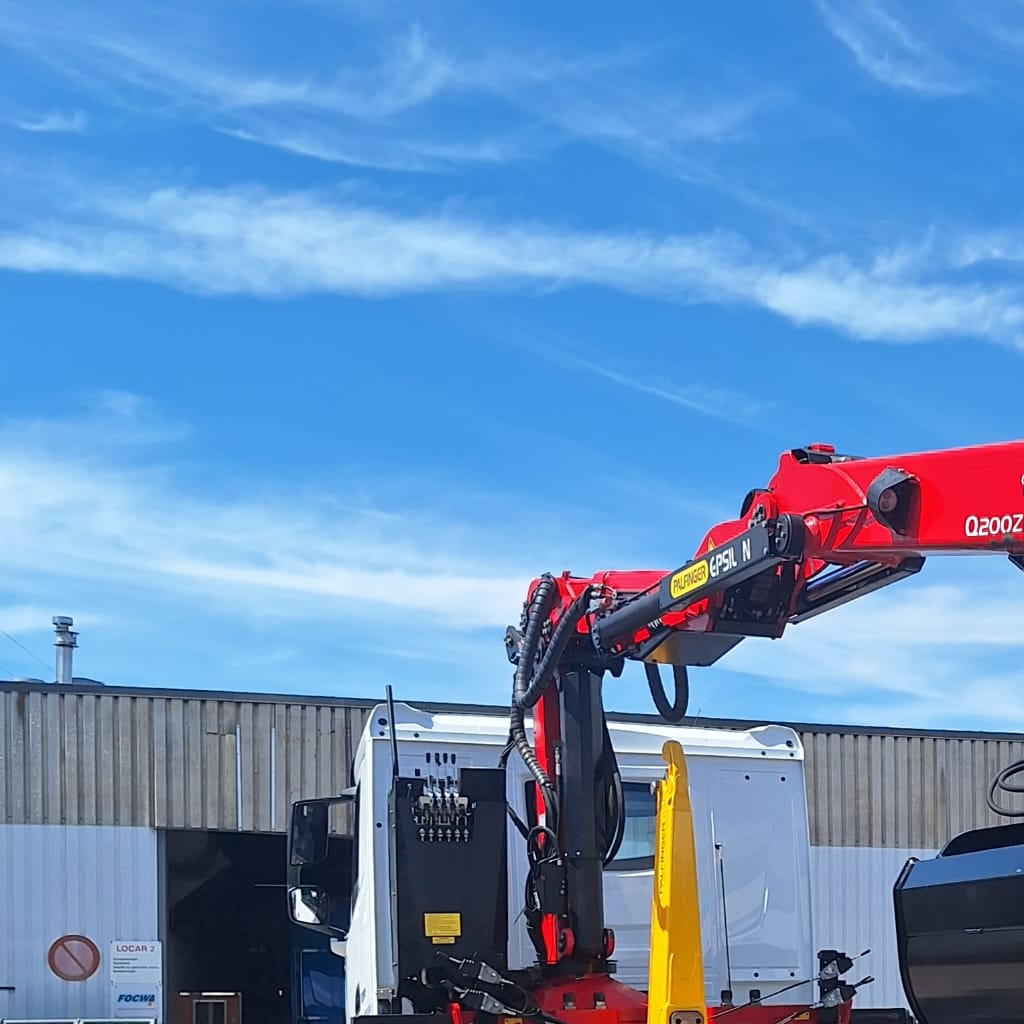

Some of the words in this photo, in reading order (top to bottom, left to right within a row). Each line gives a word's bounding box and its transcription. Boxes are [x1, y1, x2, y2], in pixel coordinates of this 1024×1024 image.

[672, 565, 707, 594] PALFINGER
[116, 945, 148, 953] LOCAR
[150, 945, 156, 953] 2
[117, 994, 156, 1003] FOCWA
